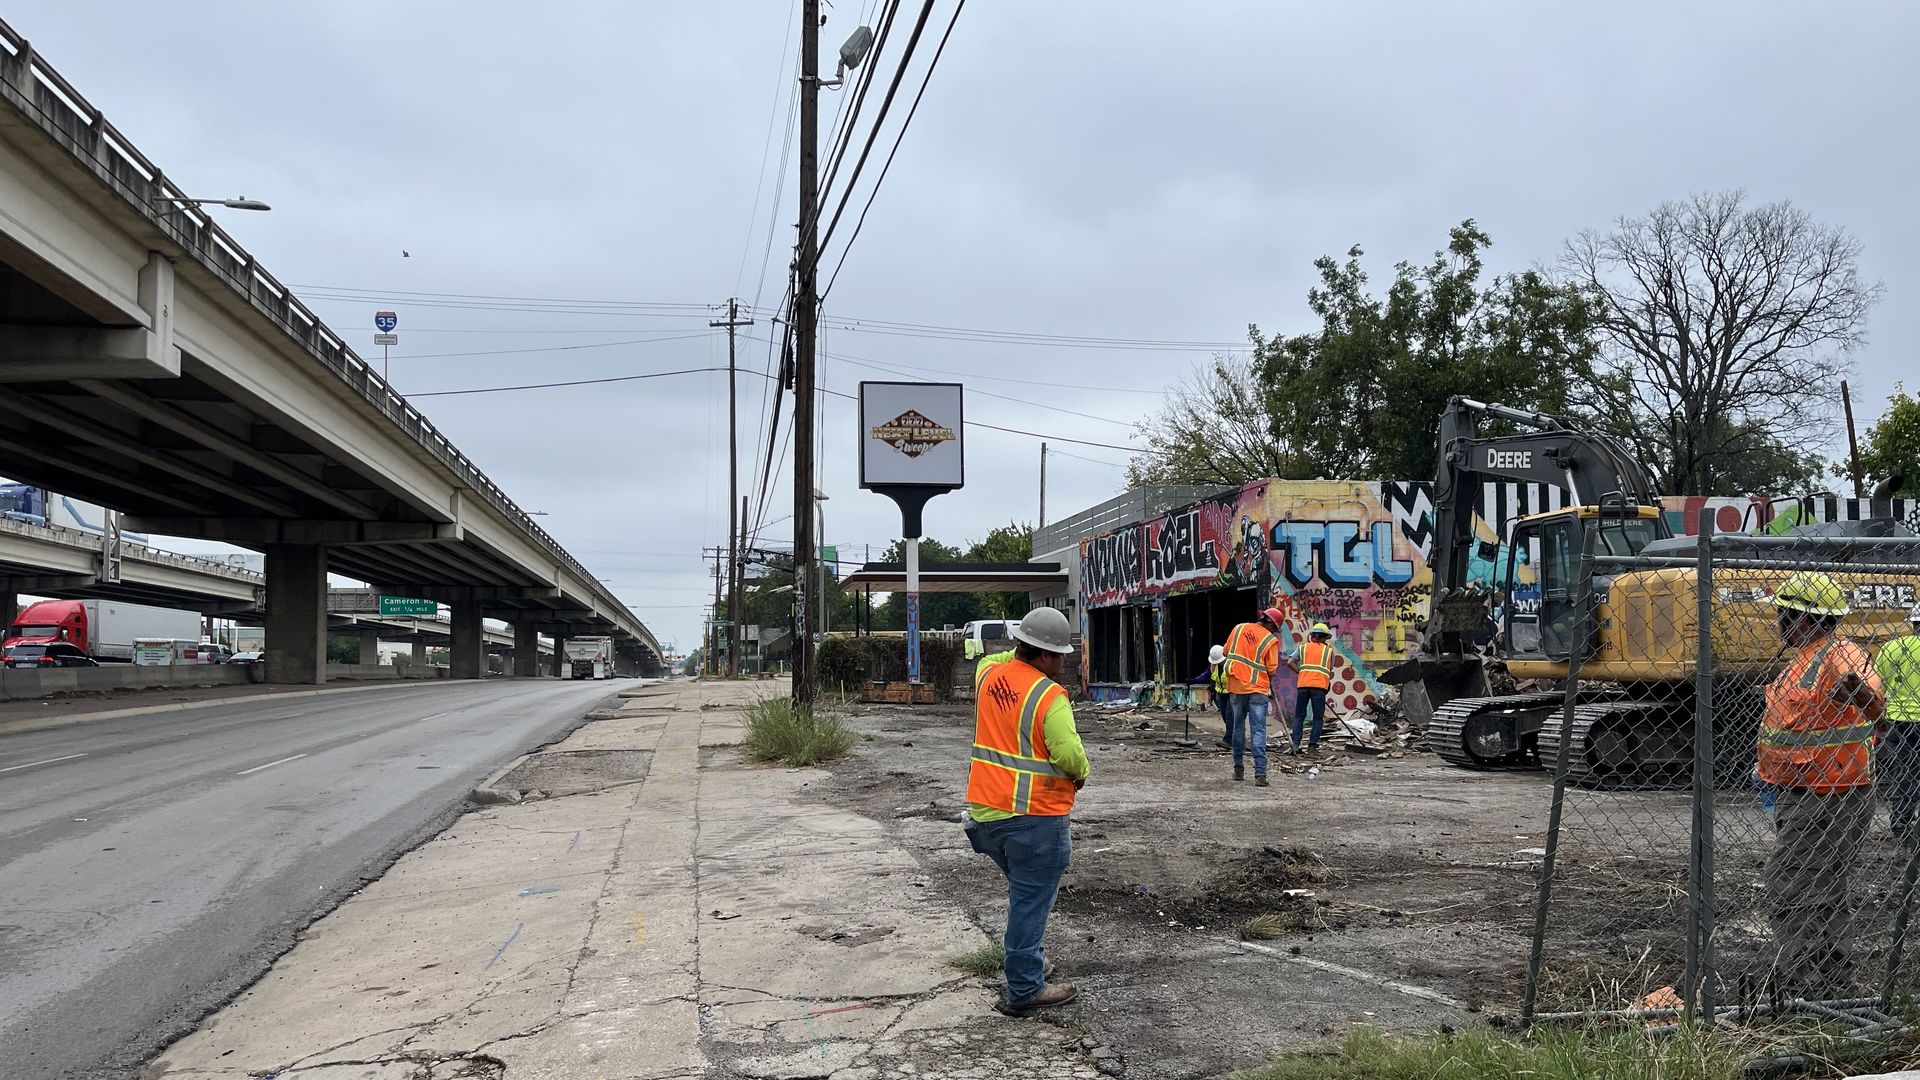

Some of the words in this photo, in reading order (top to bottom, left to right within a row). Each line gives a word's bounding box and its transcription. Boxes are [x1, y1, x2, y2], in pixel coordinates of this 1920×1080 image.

[378, 317, 395, 328] 35
[1487, 448, 1532, 469] DEERE
[1271, 520, 1413, 588] TGL
[1841, 583, 1914, 608] ERE
